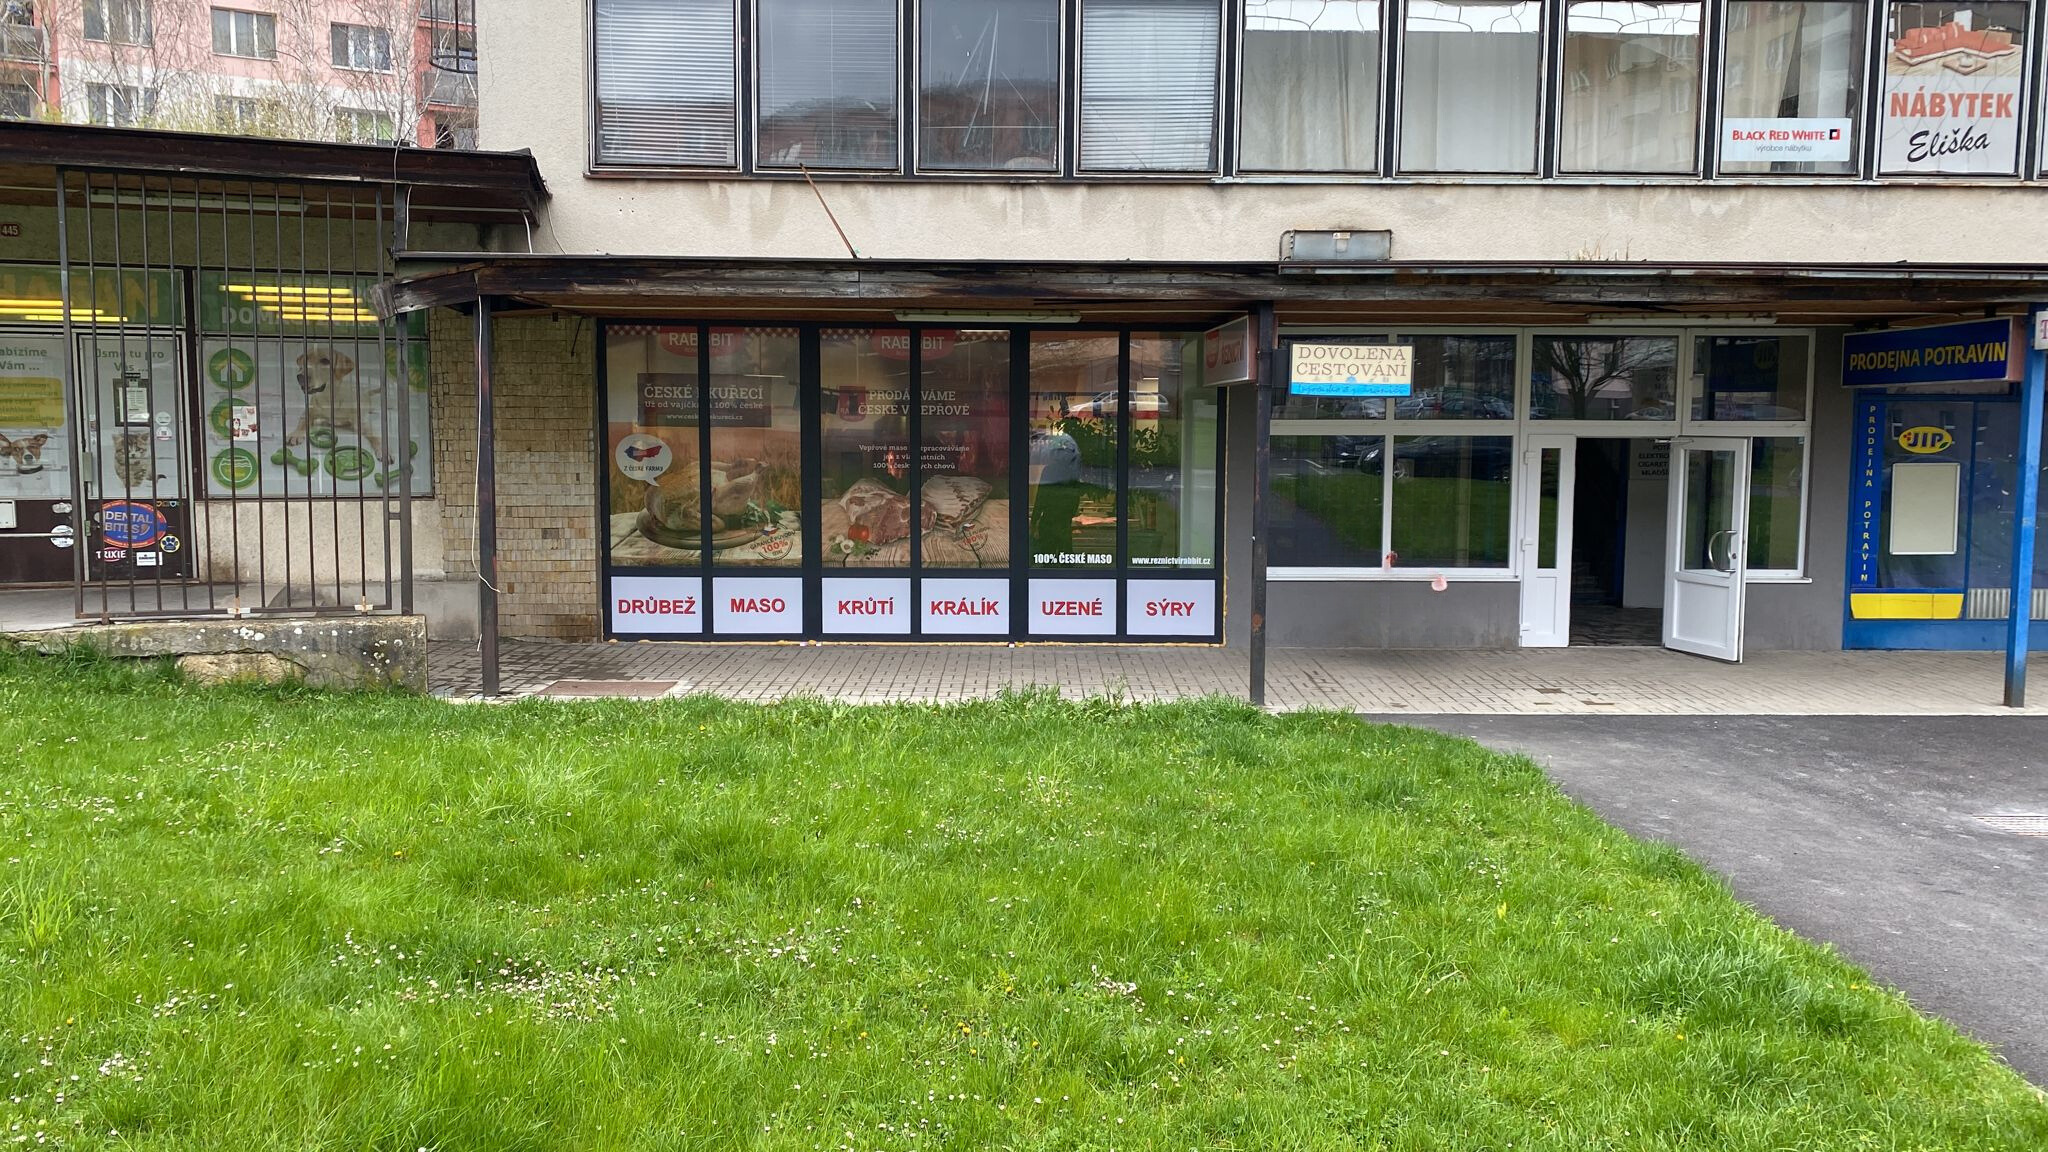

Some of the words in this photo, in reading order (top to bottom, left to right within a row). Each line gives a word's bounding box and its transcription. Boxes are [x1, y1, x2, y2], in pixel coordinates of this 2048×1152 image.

[1890, 86, 2014, 118] NÁBYTEK
[1756, 145, 1783, 153] výrobce
[1784, 144, 1812, 152] nábytku
[1907, 126, 1991, 163] Eliška
[1, 225, 18, 236] 445
[96, 348, 123, 359] Jsm
[129, 349, 142, 359] tu
[1850, 349, 1920, 372] PRODEJNA
[1924, 341, 2006, 367] POTRAVIN
[1296, 361, 1407, 377] CESTOVÁNÍ
[644, 384, 693, 399] ČESKÉ
[709, 385, 763, 400] KUŘECÍ
[869, 388, 956, 401] PRODÁVÁME
[657, 401, 668, 409] od
[715, 402, 738, 410] 100%
[858, 402, 898, 415] ČESKÉ
[901, 403, 970, 416] VEPŘOVÉ
[1865, 405, 1876, 487] PRODEJNA
[1909, 432, 1944, 448] JIP
[858, 444, 888, 453] Vepřové
[934, 462, 955, 470] chovů
[762, 540, 788, 553] 100%
[1860, 500, 1871, 582] POTRAVIN
[96, 549, 127, 559] TRIXIE
[1033, 553, 1057, 564] 100%
[1058, 551, 1086, 564] ČESKÉ
[1087, 554, 1112, 564] MASO
[1131, 556, 1211, 566] www.reznictvirabbit.cz
[618, 596, 696, 615] DRŮBEŽ
[730, 598, 786, 613] MASO
[838, 596, 894, 615] KRŮTÍ
[930, 597, 999, 616] KRÁLÍK
[1041, 597, 1103, 616] UZENÉ
[1145, 598, 1195, 617] SÝRY
